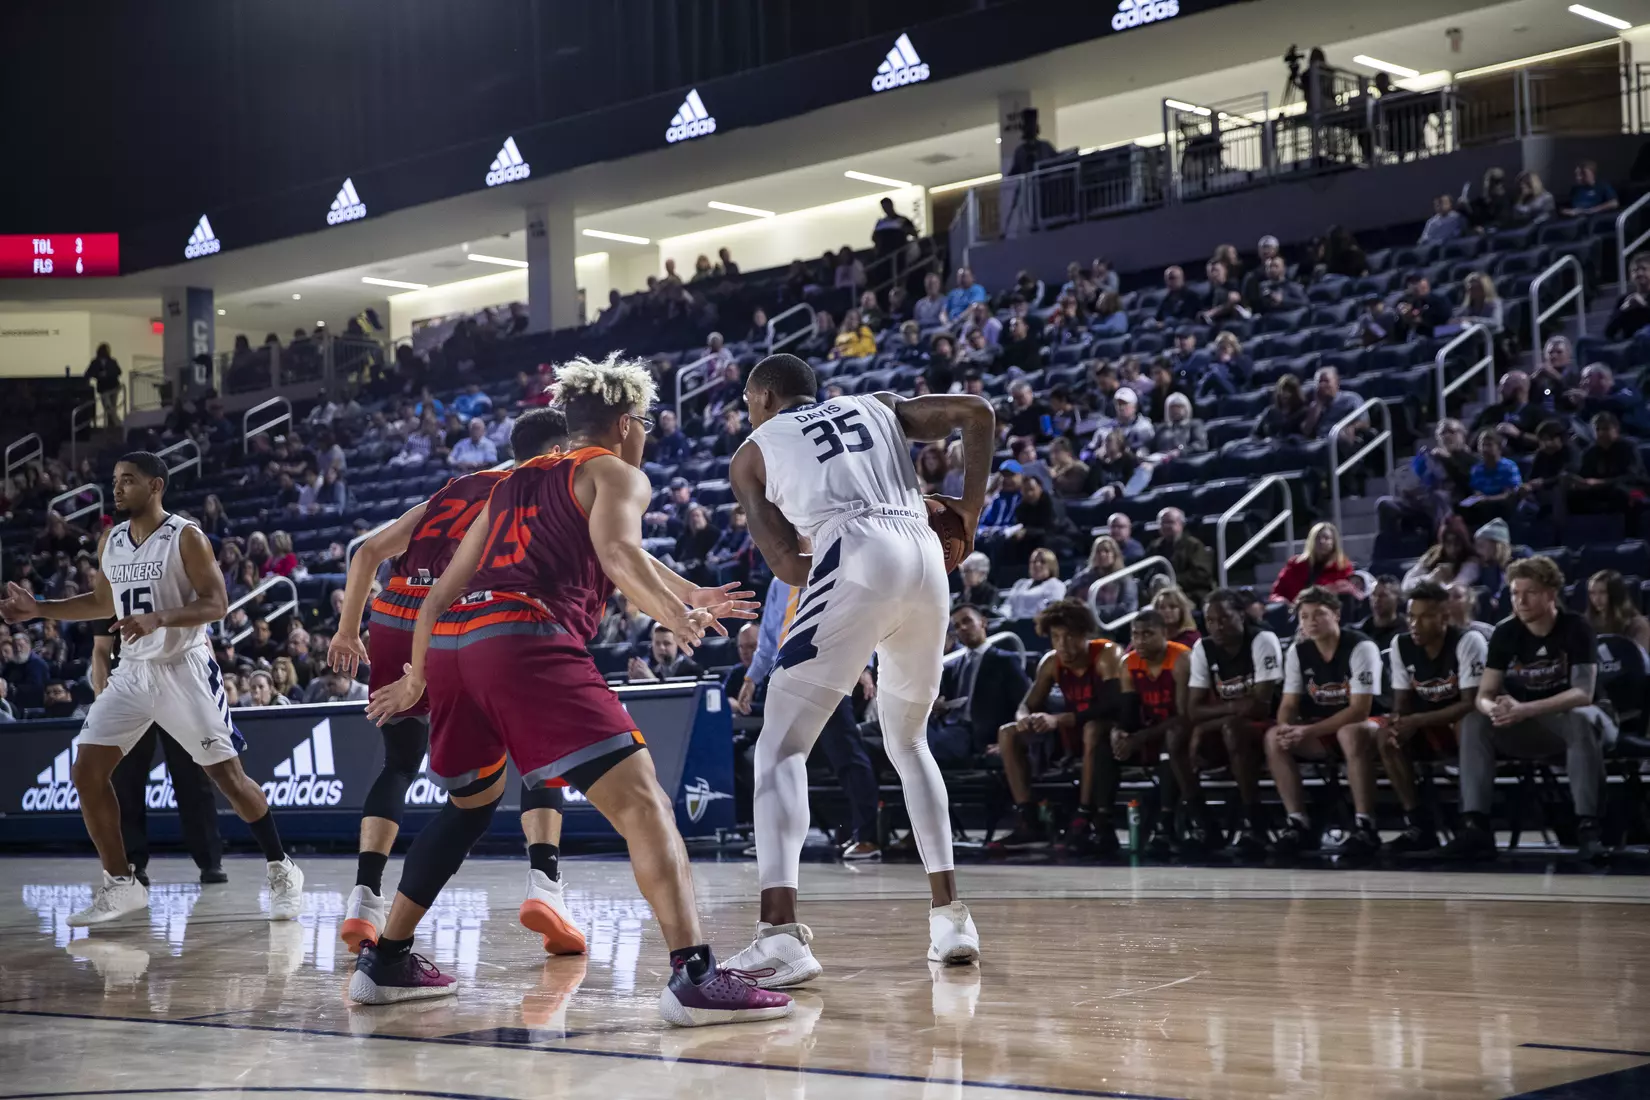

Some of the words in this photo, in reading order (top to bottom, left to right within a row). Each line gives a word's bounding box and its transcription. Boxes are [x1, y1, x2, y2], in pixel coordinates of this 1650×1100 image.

[1111, 0, 1179, 31] adidas
[872, 63, 930, 92] adidas
[665, 117, 717, 143] adidas
[485, 163, 531, 187] adidas
[327, 203, 367, 225] adidas
[32, 239, 55, 254] TOL
[75, 237, 83, 254] 3
[184, 239, 221, 259] adidas
[33, 258, 53, 274] FLS
[794, 404, 841, 423] DAVIS
[801, 409, 874, 464] 35
[882, 507, 920, 519] LanceUp
[476, 505, 538, 572] 15
[110, 561, 163, 584] LANCERS
[120, 586, 154, 616] 15
[21, 780, 80, 811] adida
[260, 773, 344, 806] adidas
